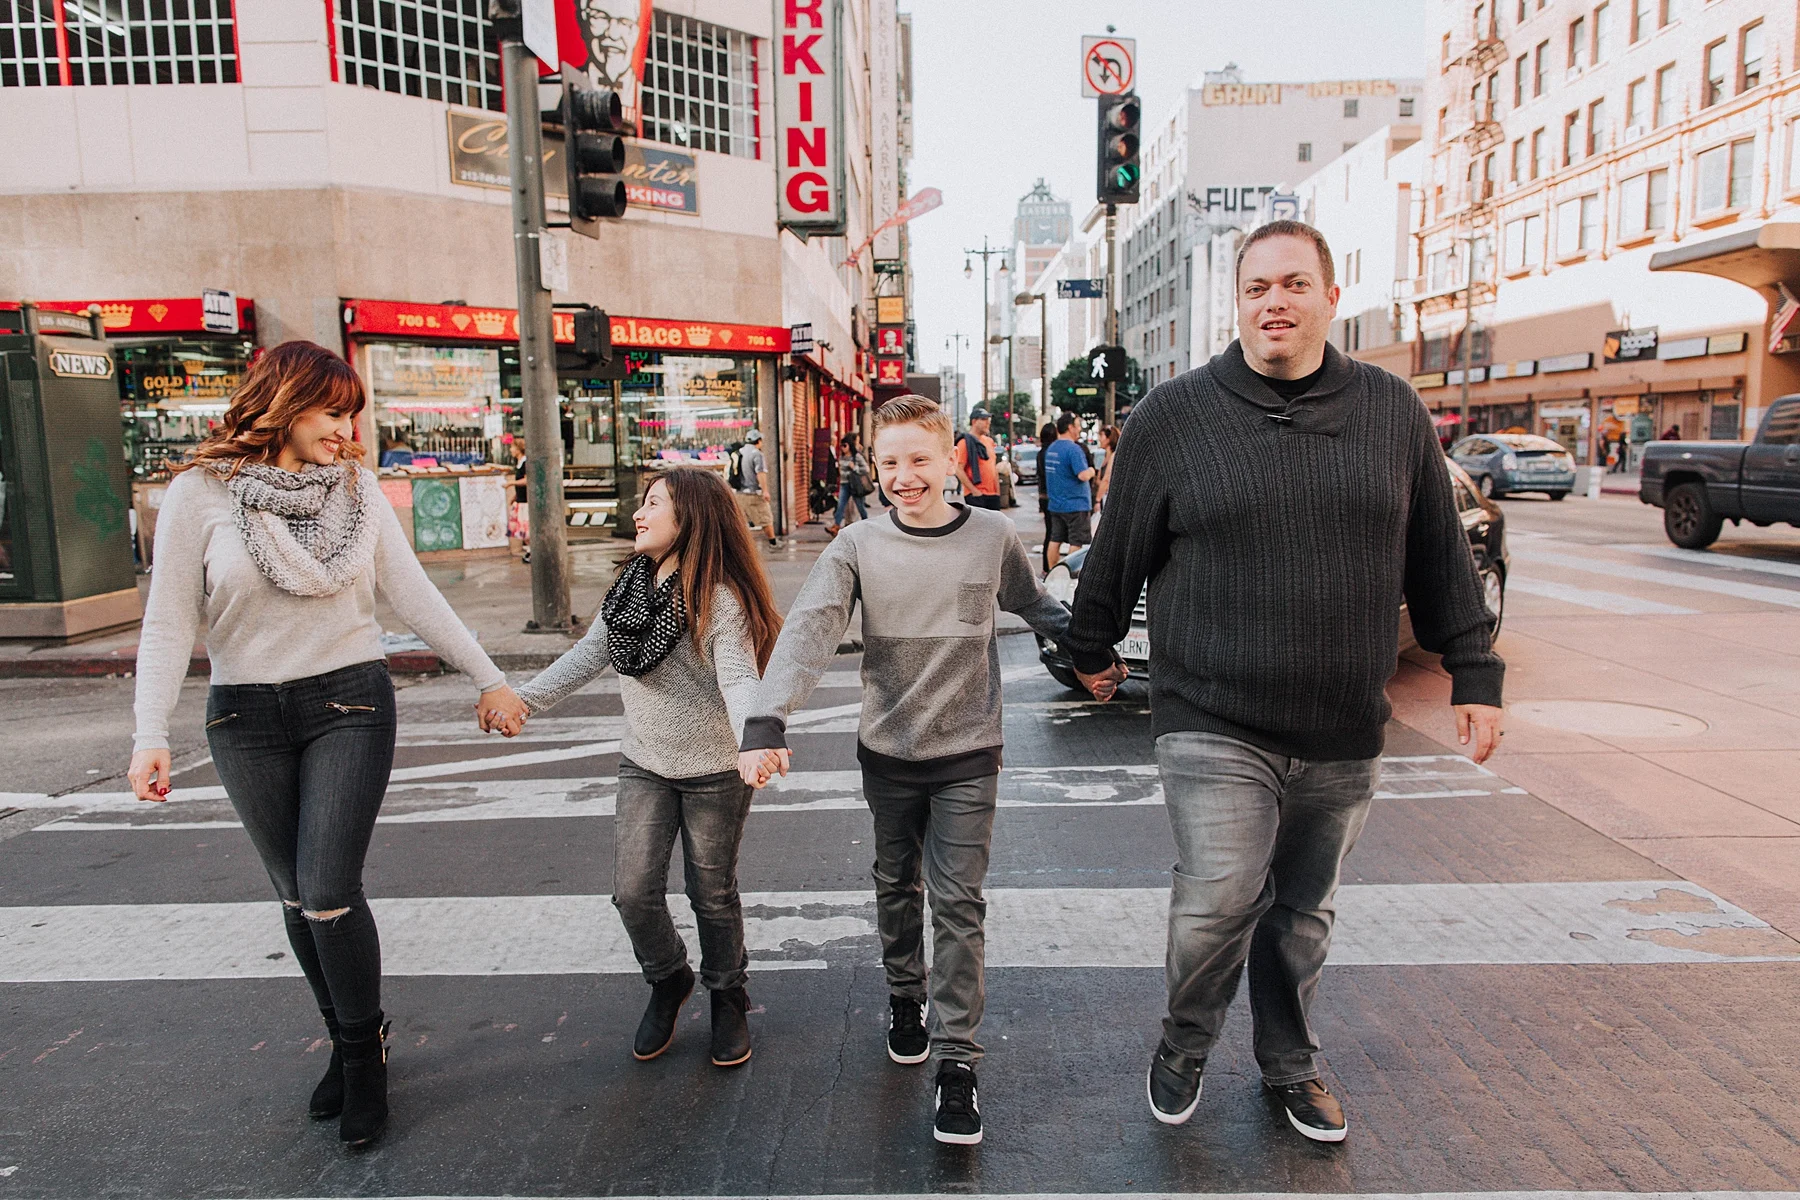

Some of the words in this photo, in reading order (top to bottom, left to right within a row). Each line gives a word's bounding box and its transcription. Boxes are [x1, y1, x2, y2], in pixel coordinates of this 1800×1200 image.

[782, 0, 830, 214] RKING
[621, 158, 691, 187] nter
[880, 112, 893, 246] APARTMENS
[625, 187, 684, 207] KING
[1090, 280, 1102, 291] St
[38, 316, 54, 326] LOS
[56, 317, 91, 332] ANGELES
[397, 314, 423, 327] 700
[426, 315, 441, 328] S.
[611, 320, 683, 345] alace
[748, 335, 765, 346] 700
[1620, 331, 1657, 350] boost
[55, 353, 108, 376] NEWS
[143, 375, 184, 390] GOLD
[682, 379, 705, 389] OLD
[706, 380, 742, 391] PALACE
